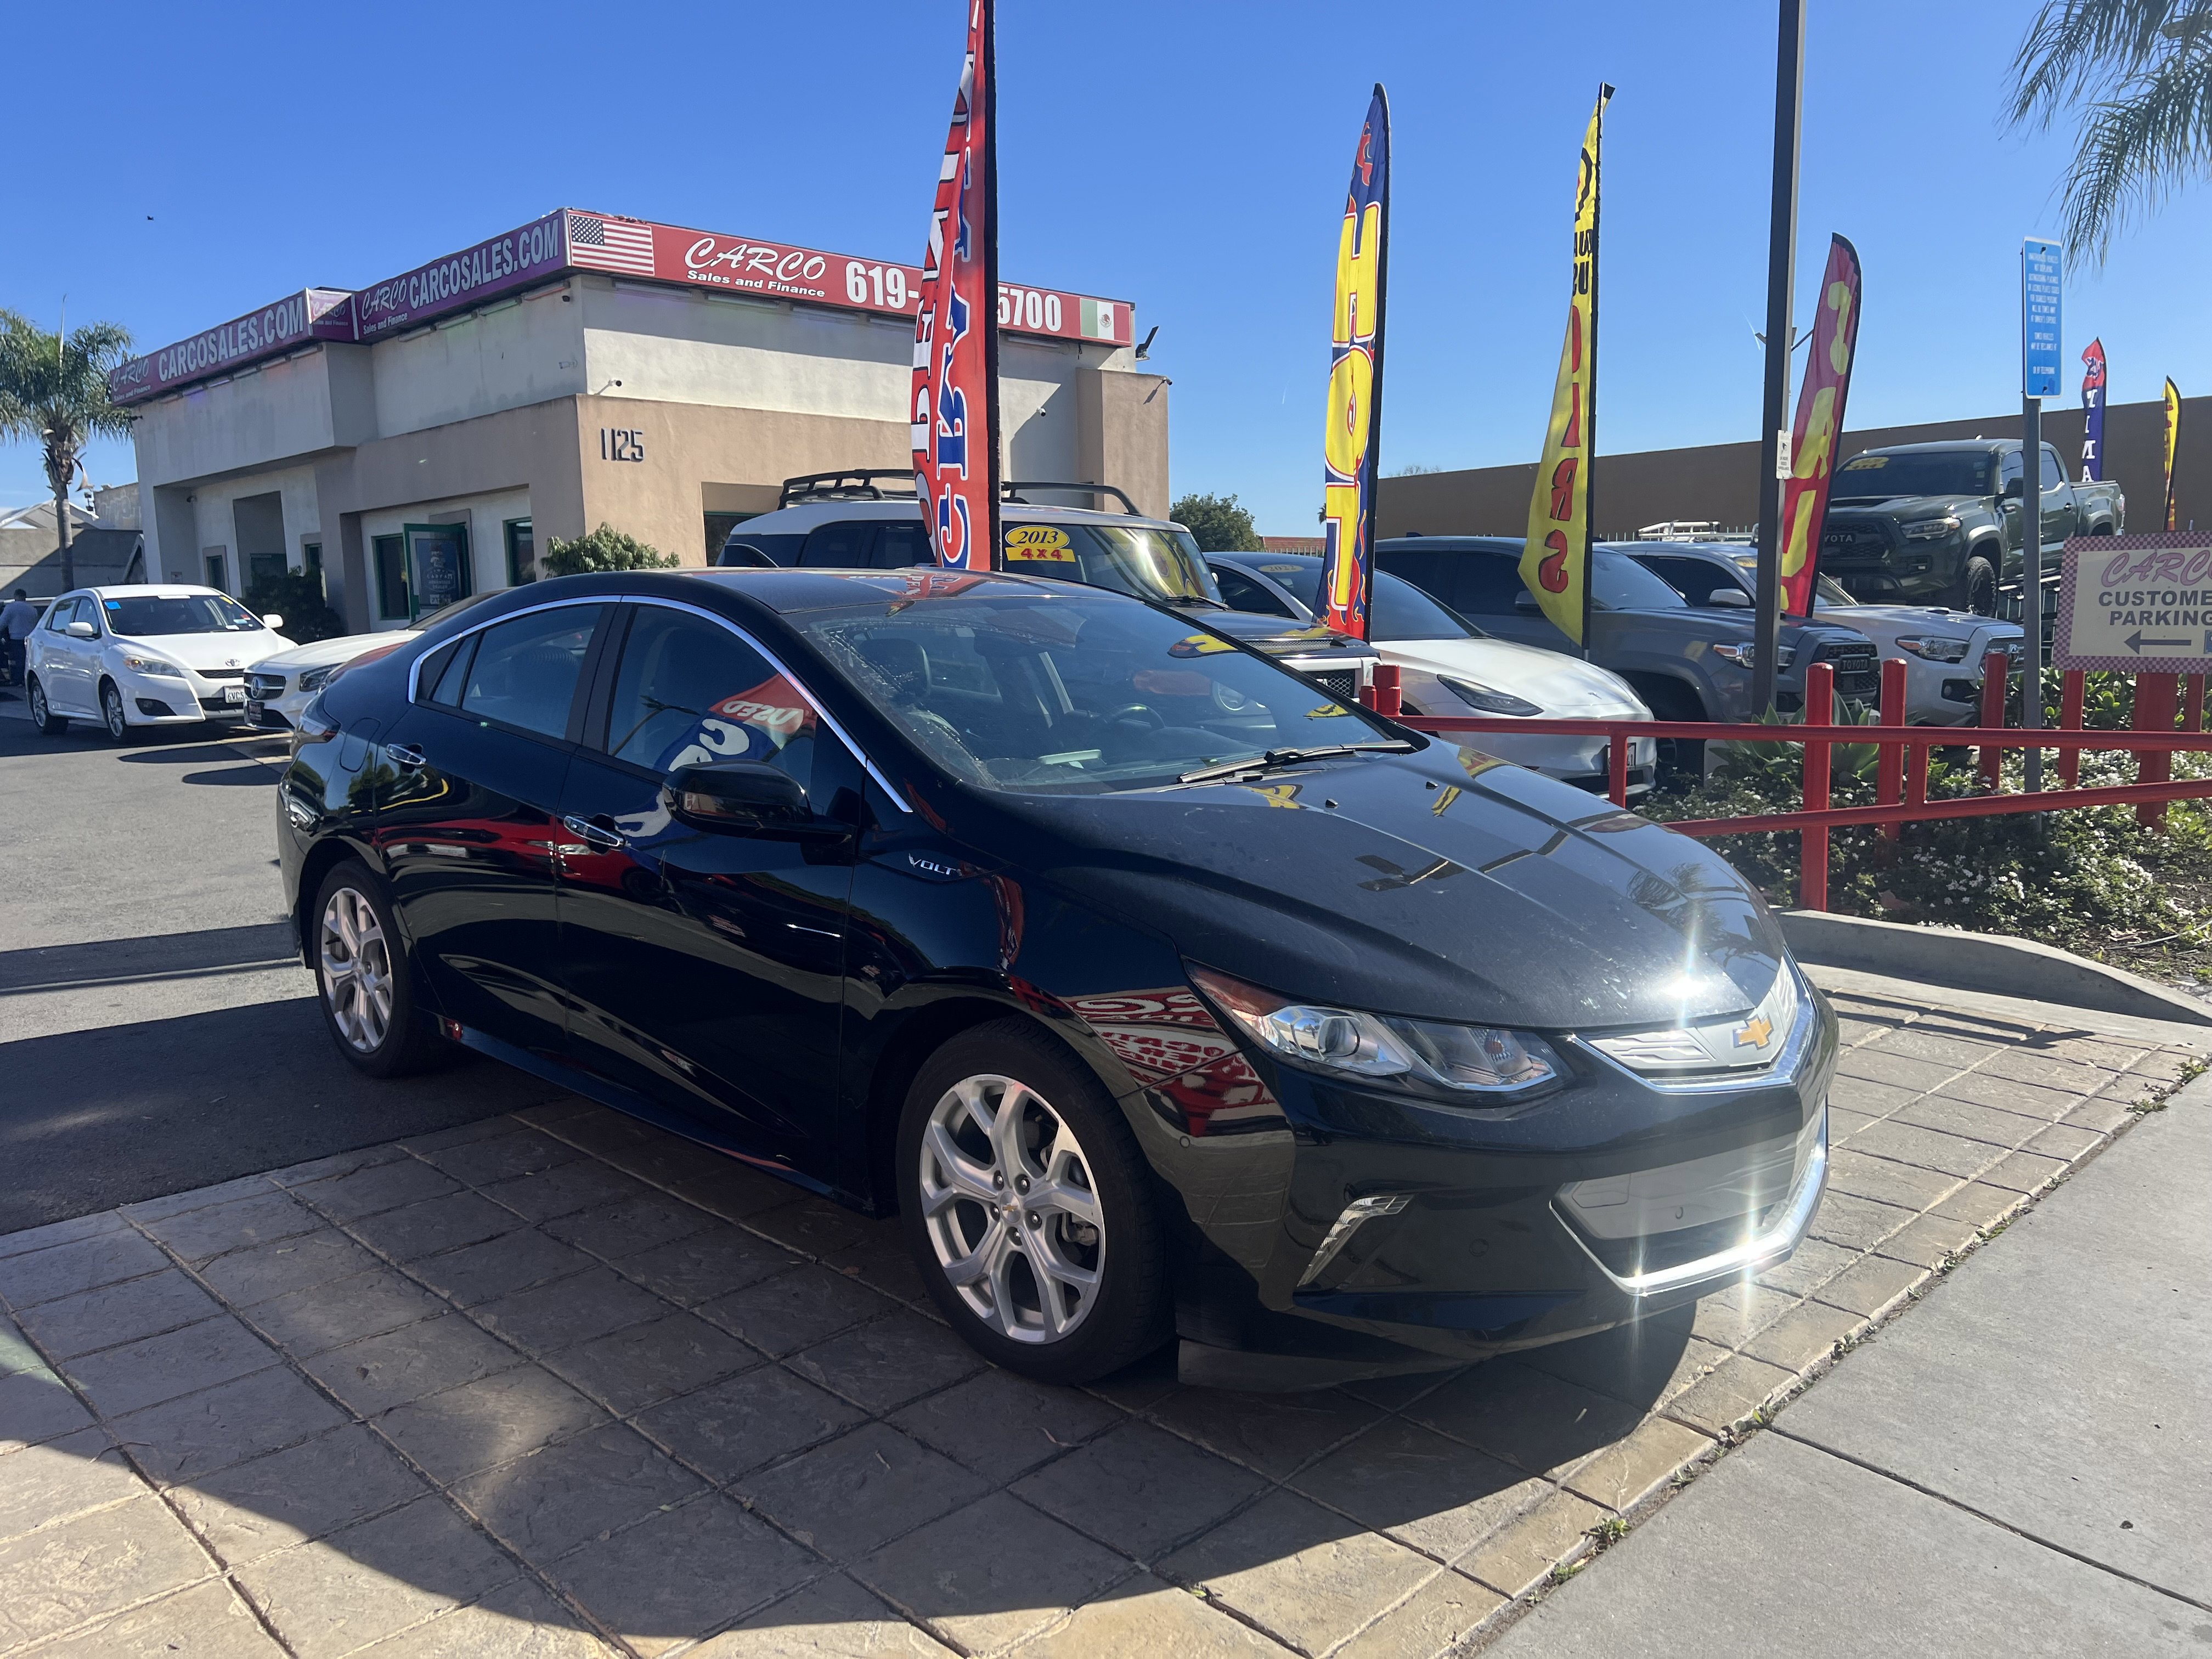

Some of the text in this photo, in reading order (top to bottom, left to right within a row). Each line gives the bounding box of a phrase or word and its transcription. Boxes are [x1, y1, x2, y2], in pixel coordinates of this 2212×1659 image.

[409, 219, 559, 309] CARCOSALES.COM
[684, 237, 826, 281] CARCO
[362, 278, 407, 321] CARCO
[687, 270, 825, 297] Sales and Finance
[158, 296, 303, 381] CARCOSALES.COM
[363, 312, 408, 335] Sales and Finance
[112, 358, 149, 392] CARCO
[114, 385, 151, 402] Sales and Finance
[1325, 201, 1381, 611] HOT
[601, 427, 644, 462] 1125
[1016, 531, 1059, 544] 2013
[1824, 534, 1853, 543] YOTA
[2101, 549, 2212, 588] CARC
[2109, 610, 2212, 626] PARKING
[909, 853, 957, 876] VOLT
